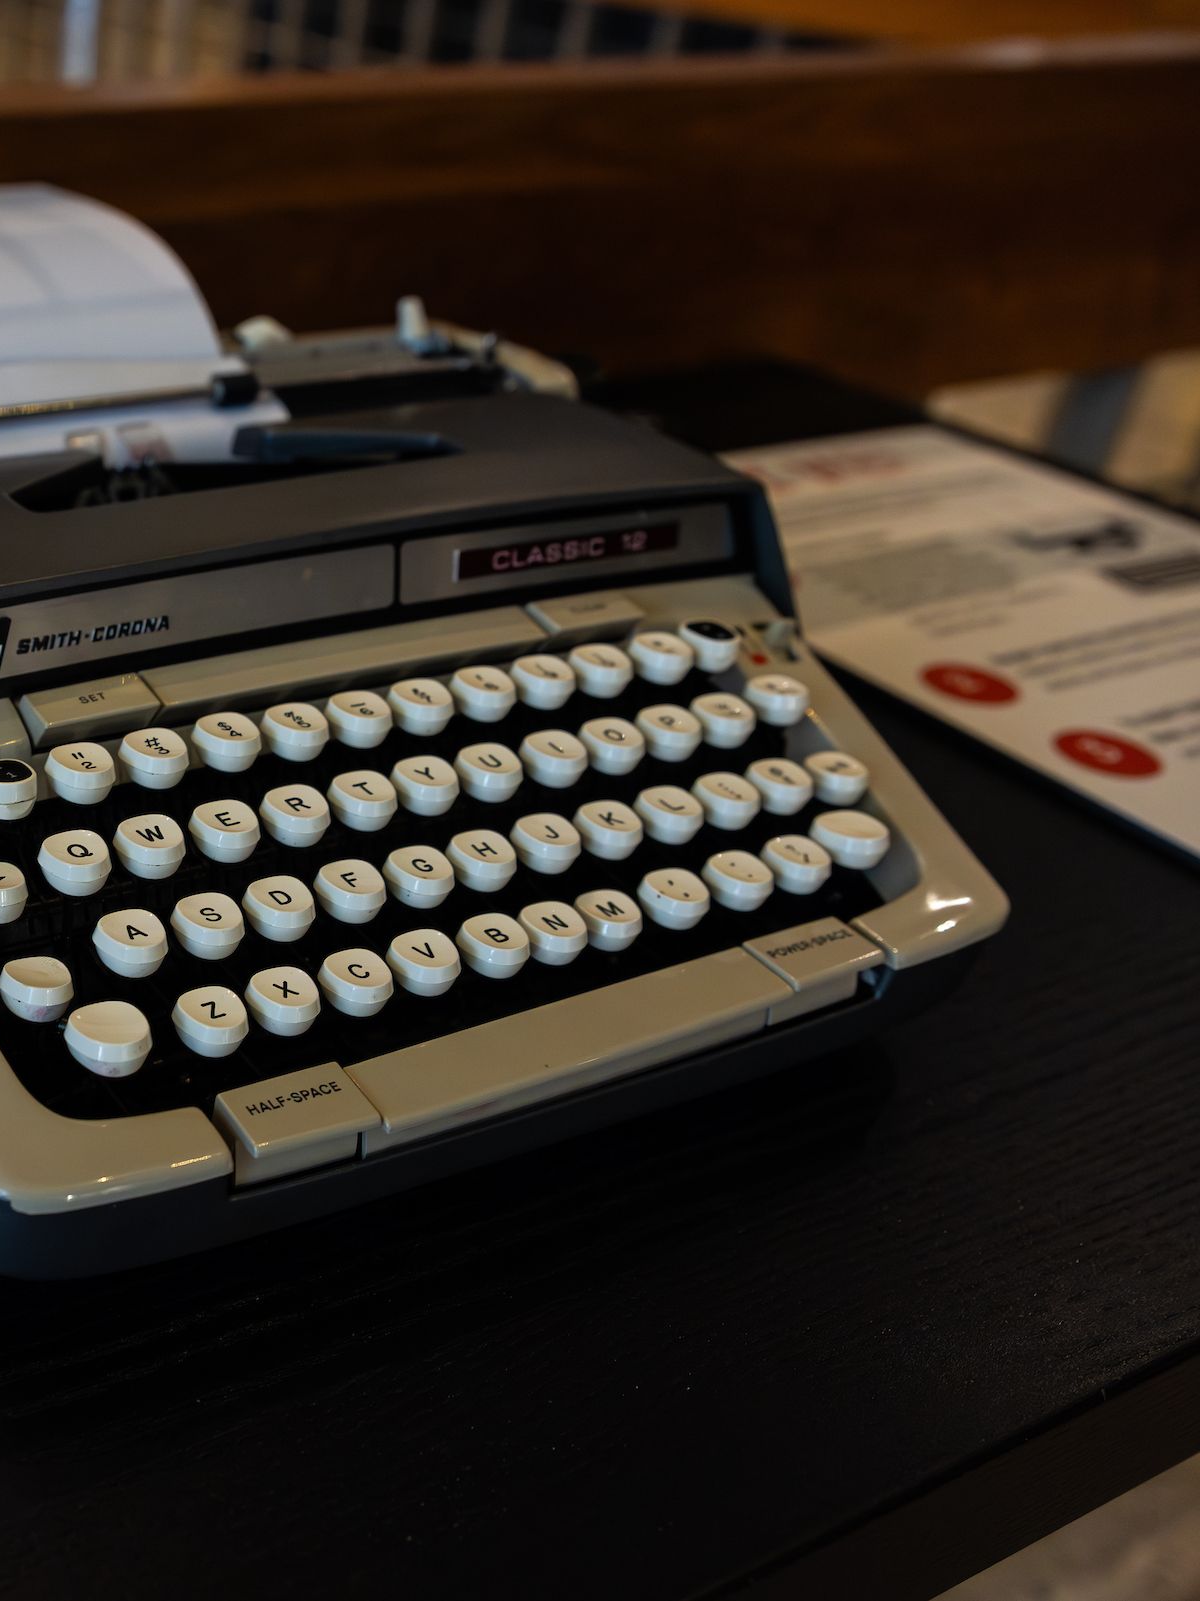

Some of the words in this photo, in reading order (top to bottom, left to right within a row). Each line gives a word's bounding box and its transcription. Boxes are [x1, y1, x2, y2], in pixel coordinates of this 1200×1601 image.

[490, 535, 606, 572] CLASSIC
[15, 615, 171, 655] SMITH-CORONA
[78, 691, 107, 705] SET
[478, 753, 502, 768] U
[413, 766, 435, 780] Y
[352, 781, 374, 796] T
[284, 796, 312, 812] R
[658, 798, 686, 812] L
[214, 811, 241, 827] E
[598, 811, 625, 826] K
[135, 825, 165, 842] W
[545, 824, 560, 840] J
[66, 843, 93, 858] Q
[471, 841, 498, 858] H
[411, 858, 434, 873] G
[340, 871, 358, 888] F
[268, 889, 293, 906] D
[199, 907, 223, 923] S
[596, 900, 625, 918] M
[541, 913, 569, 931] N
[125, 923, 149, 940] A
[484, 927, 510, 943] B
[411, 942, 435, 959] V
[347, 963, 371, 979] C
[272, 980, 300, 999] X
[200, 1000, 227, 1019] Z
[246, 1081, 342, 1116] HALF-SPACE
